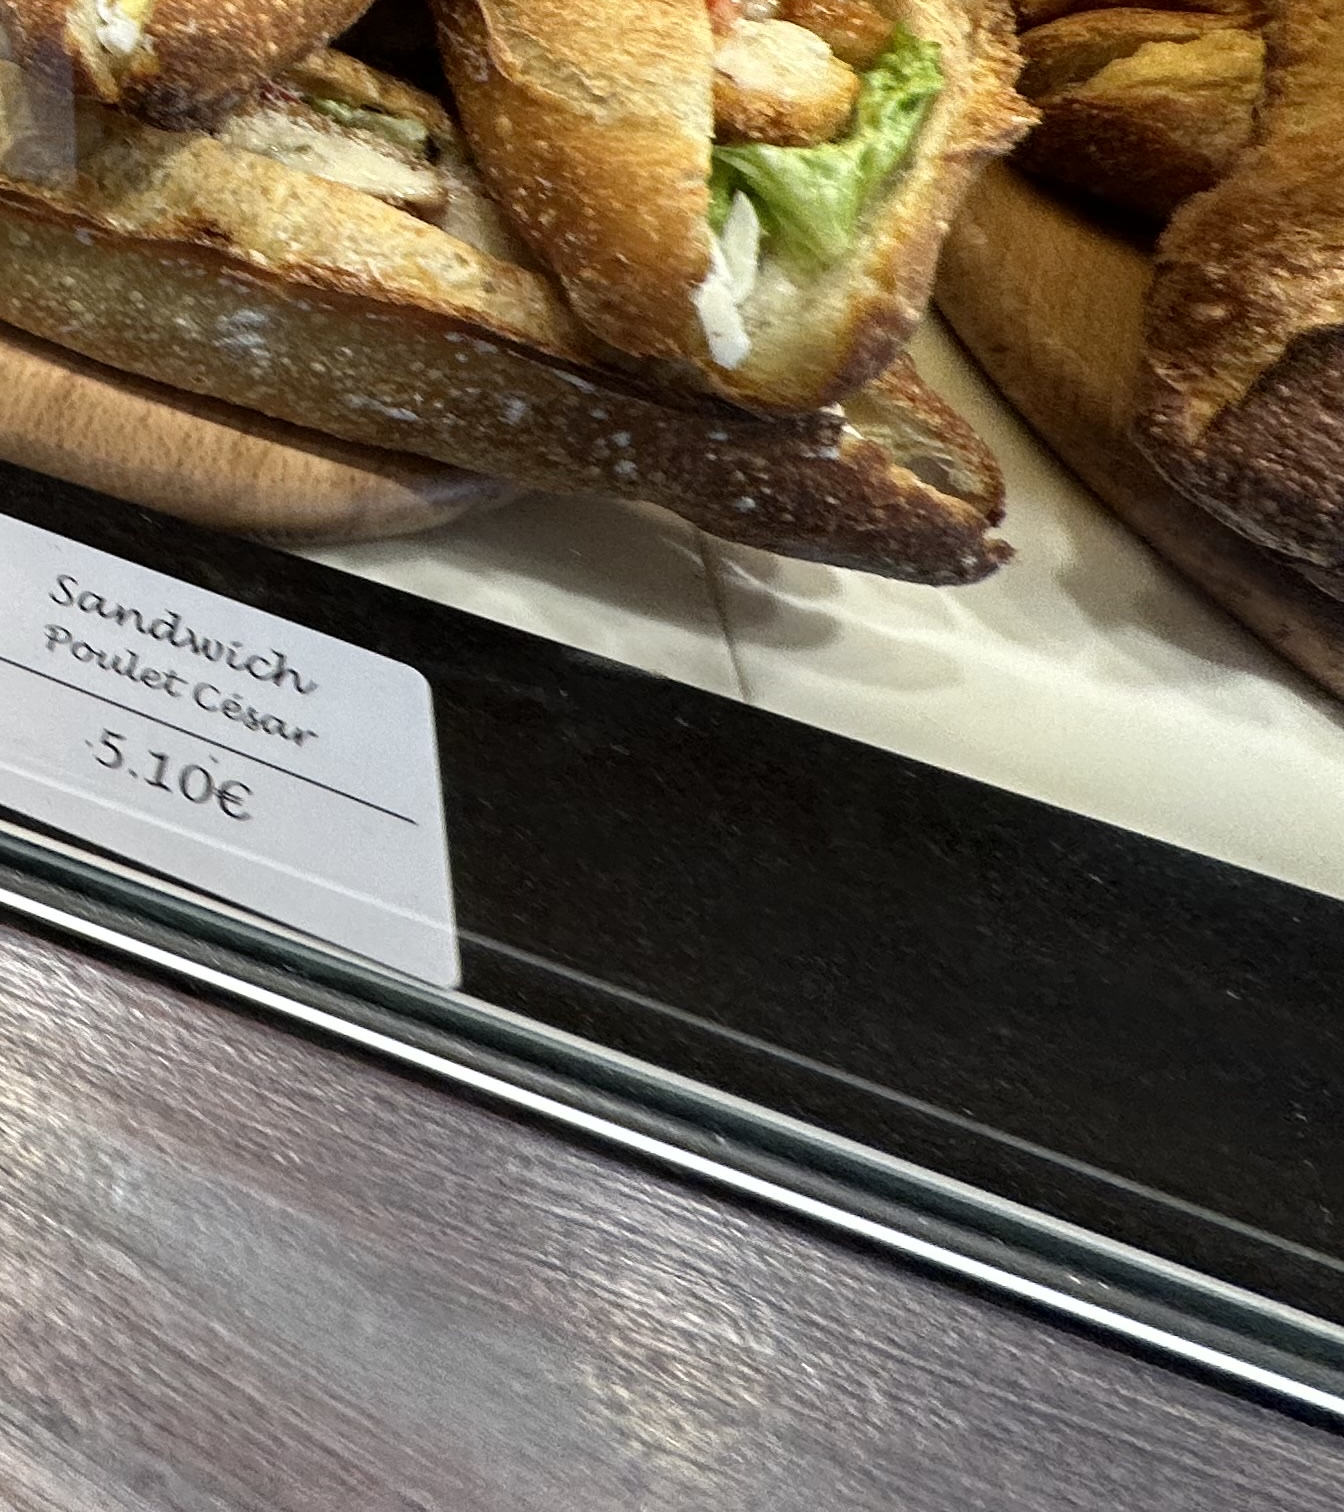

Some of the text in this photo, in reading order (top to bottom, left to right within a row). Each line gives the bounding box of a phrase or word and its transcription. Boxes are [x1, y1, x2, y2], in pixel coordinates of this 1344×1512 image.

[44, 624, 319, 747] Poulet César
[48, 574, 319, 694] Sandwich
[94, 728, 254, 821] 5.10€
